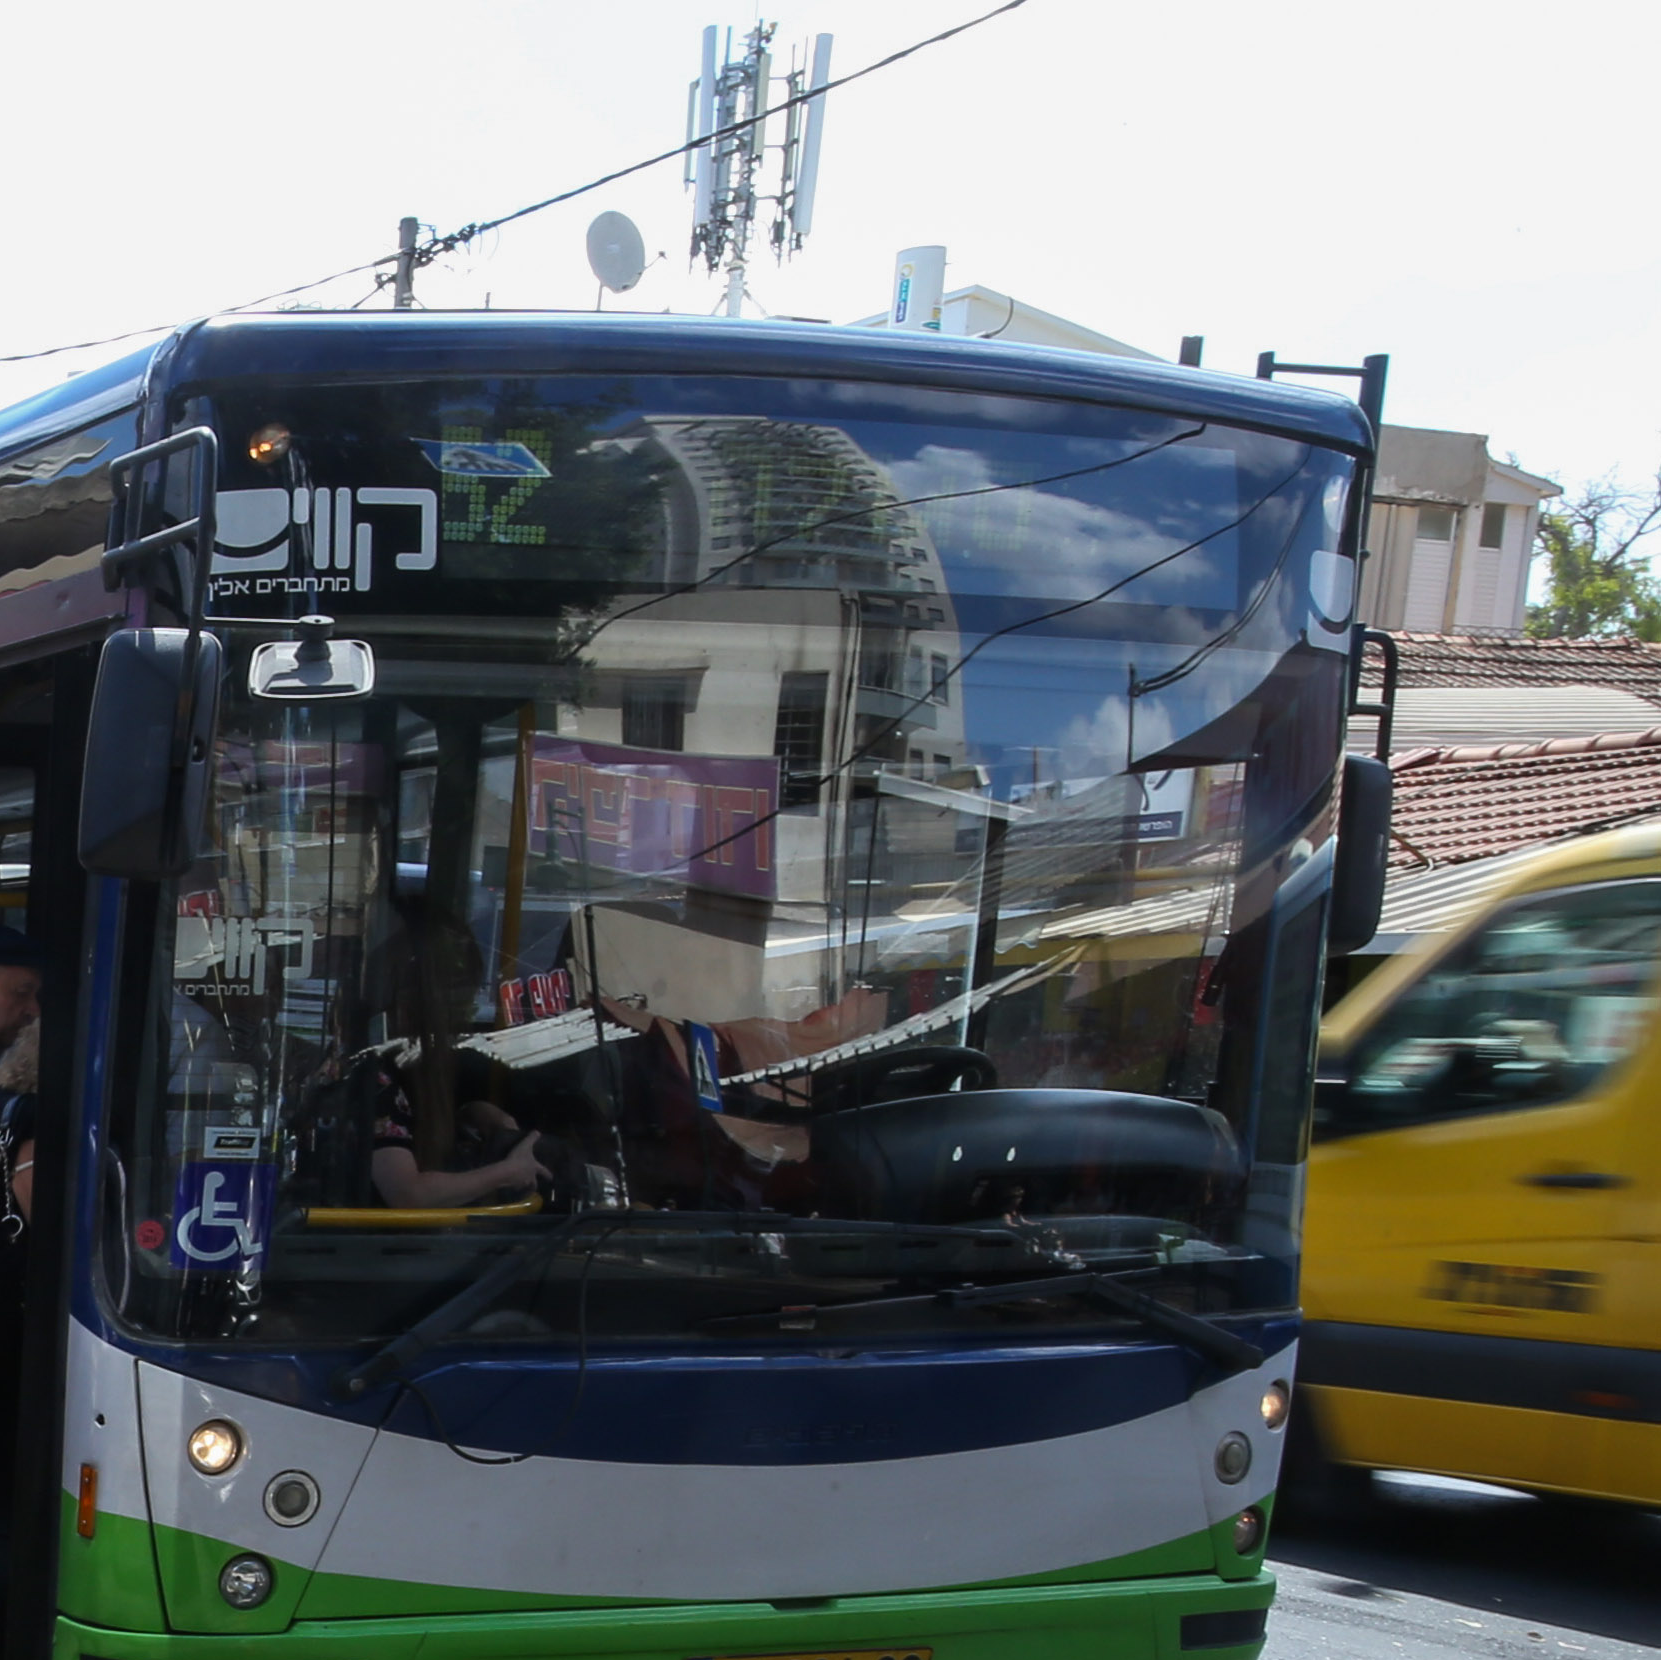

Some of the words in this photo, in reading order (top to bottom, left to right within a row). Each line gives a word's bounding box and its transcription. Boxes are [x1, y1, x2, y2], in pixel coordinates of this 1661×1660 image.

[211, 486, 438, 592] קווים
[256, 577, 351, 595] מתחברים
[174, 917, 315, 995] קווים
[185, 984, 250, 996] מתחברים
